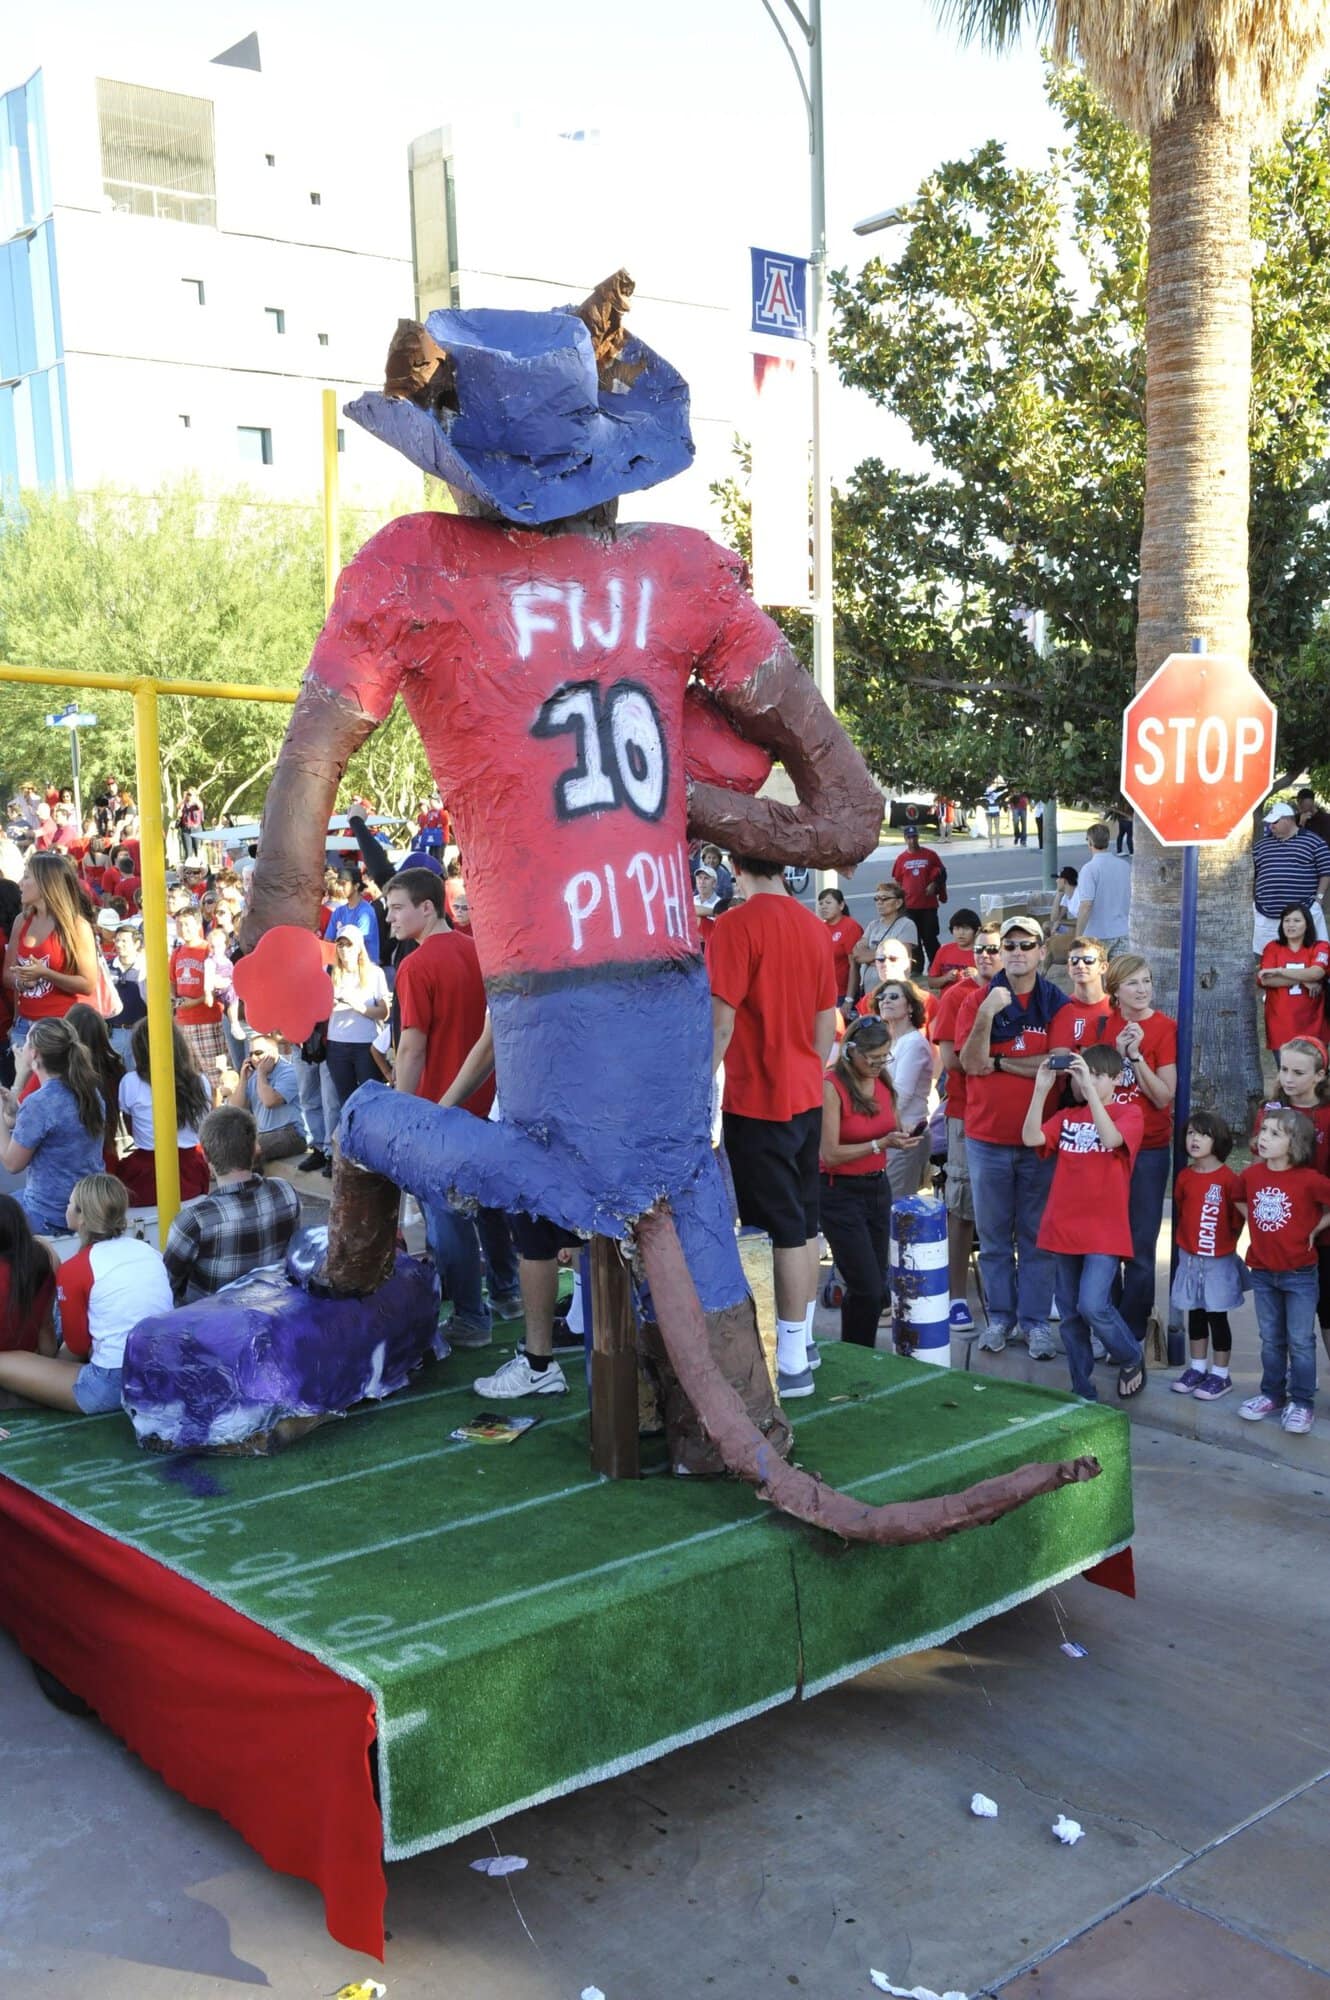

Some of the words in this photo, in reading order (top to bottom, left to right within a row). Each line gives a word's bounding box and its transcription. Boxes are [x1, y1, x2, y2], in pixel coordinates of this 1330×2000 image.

[756, 257, 802, 331] A
[510, 577, 653, 661] FIJI
[530, 679, 670, 823] 10
[1134, 715, 1265, 786] STOP
[564, 865, 622, 952] PI
[625, 843, 693, 949] PHI
